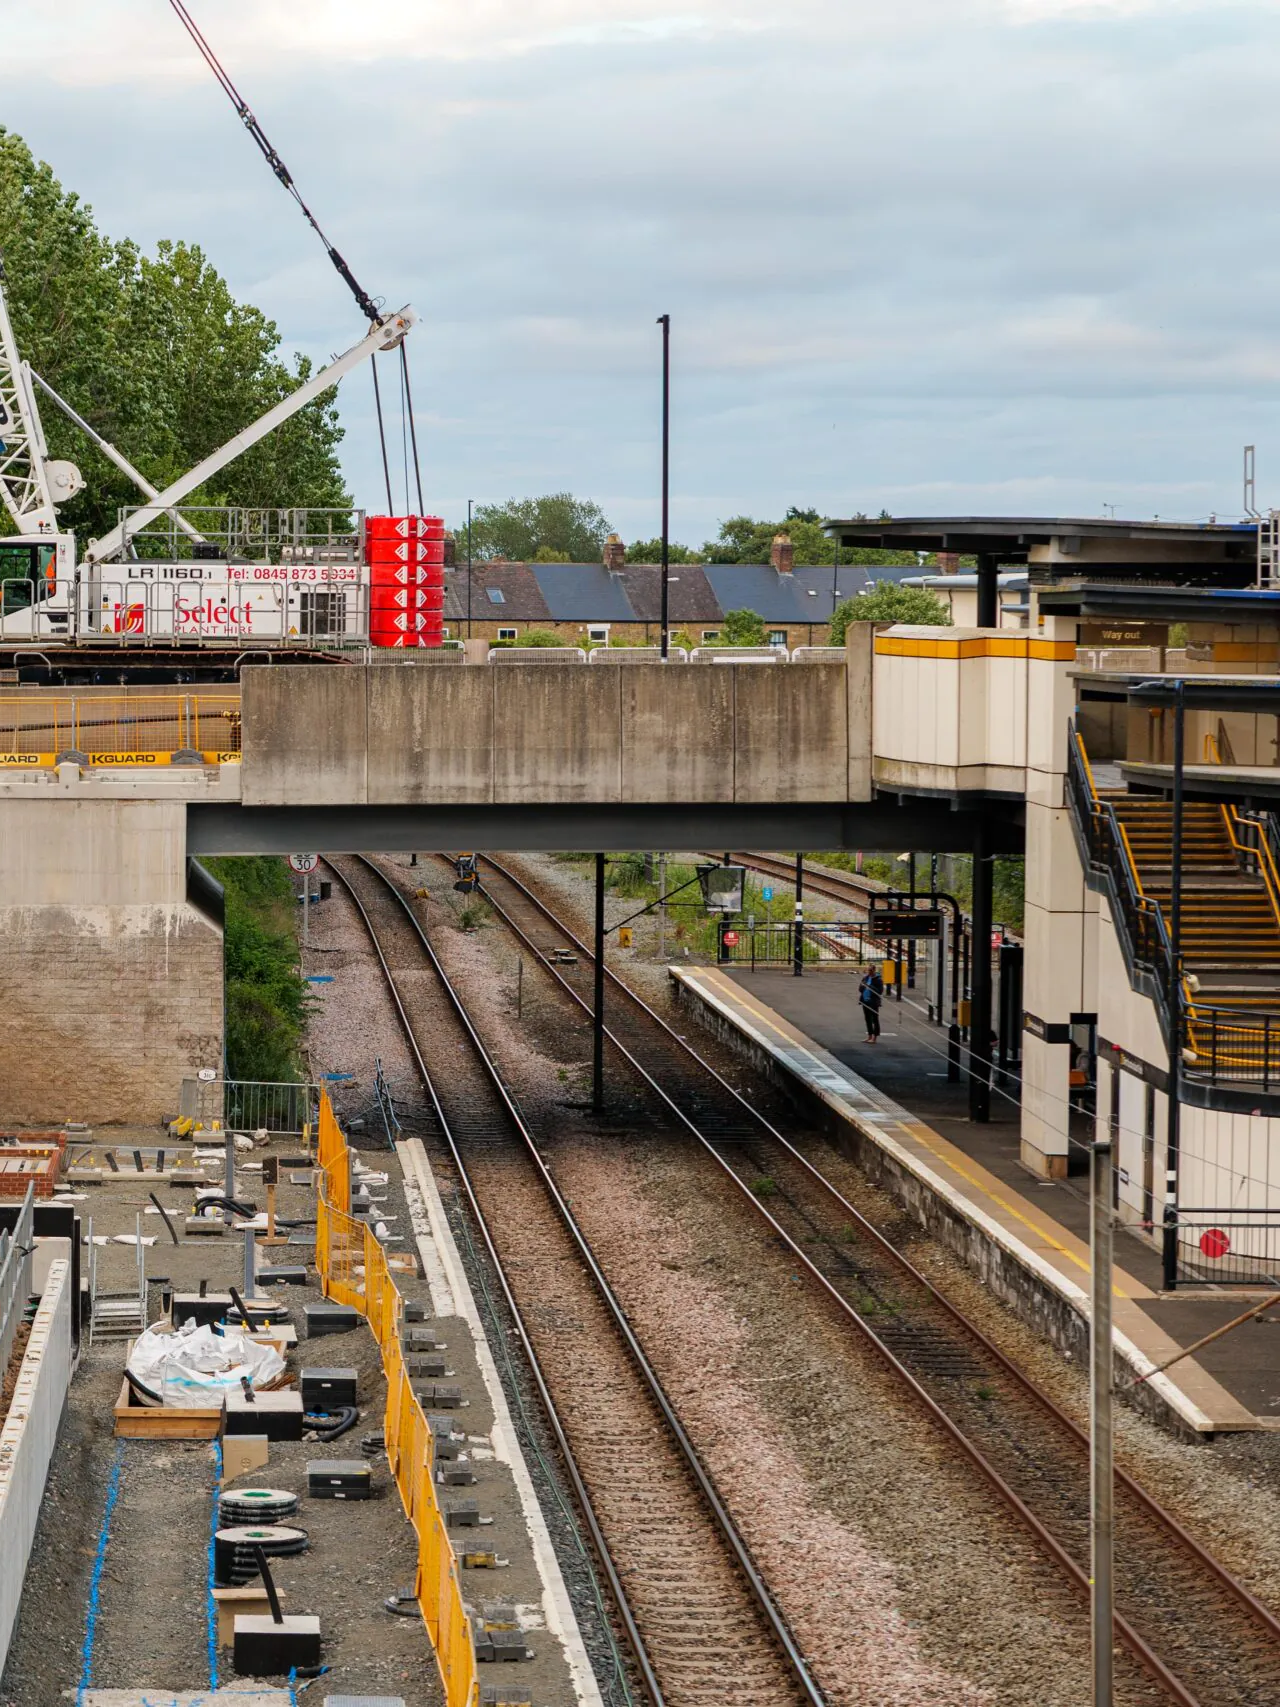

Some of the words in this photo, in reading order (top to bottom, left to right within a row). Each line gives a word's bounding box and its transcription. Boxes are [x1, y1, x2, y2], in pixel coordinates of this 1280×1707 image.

[128, 568, 154, 579] LR
[163, 568, 212, 579] 1160.1
[226, 568, 249, 579] Tel:
[253, 568, 287, 579] 0845
[291, 568, 317, 580] 873
[175, 598, 253, 624] Select
[174, 625, 219, 634] PLANT
[224, 625, 253, 634] HIRE
[1102, 630, 1123, 641] Way
[1124, 631, 1141, 639] out
[92, 754, 156, 764] KGUARD
[296, 859, 311, 871] 30
